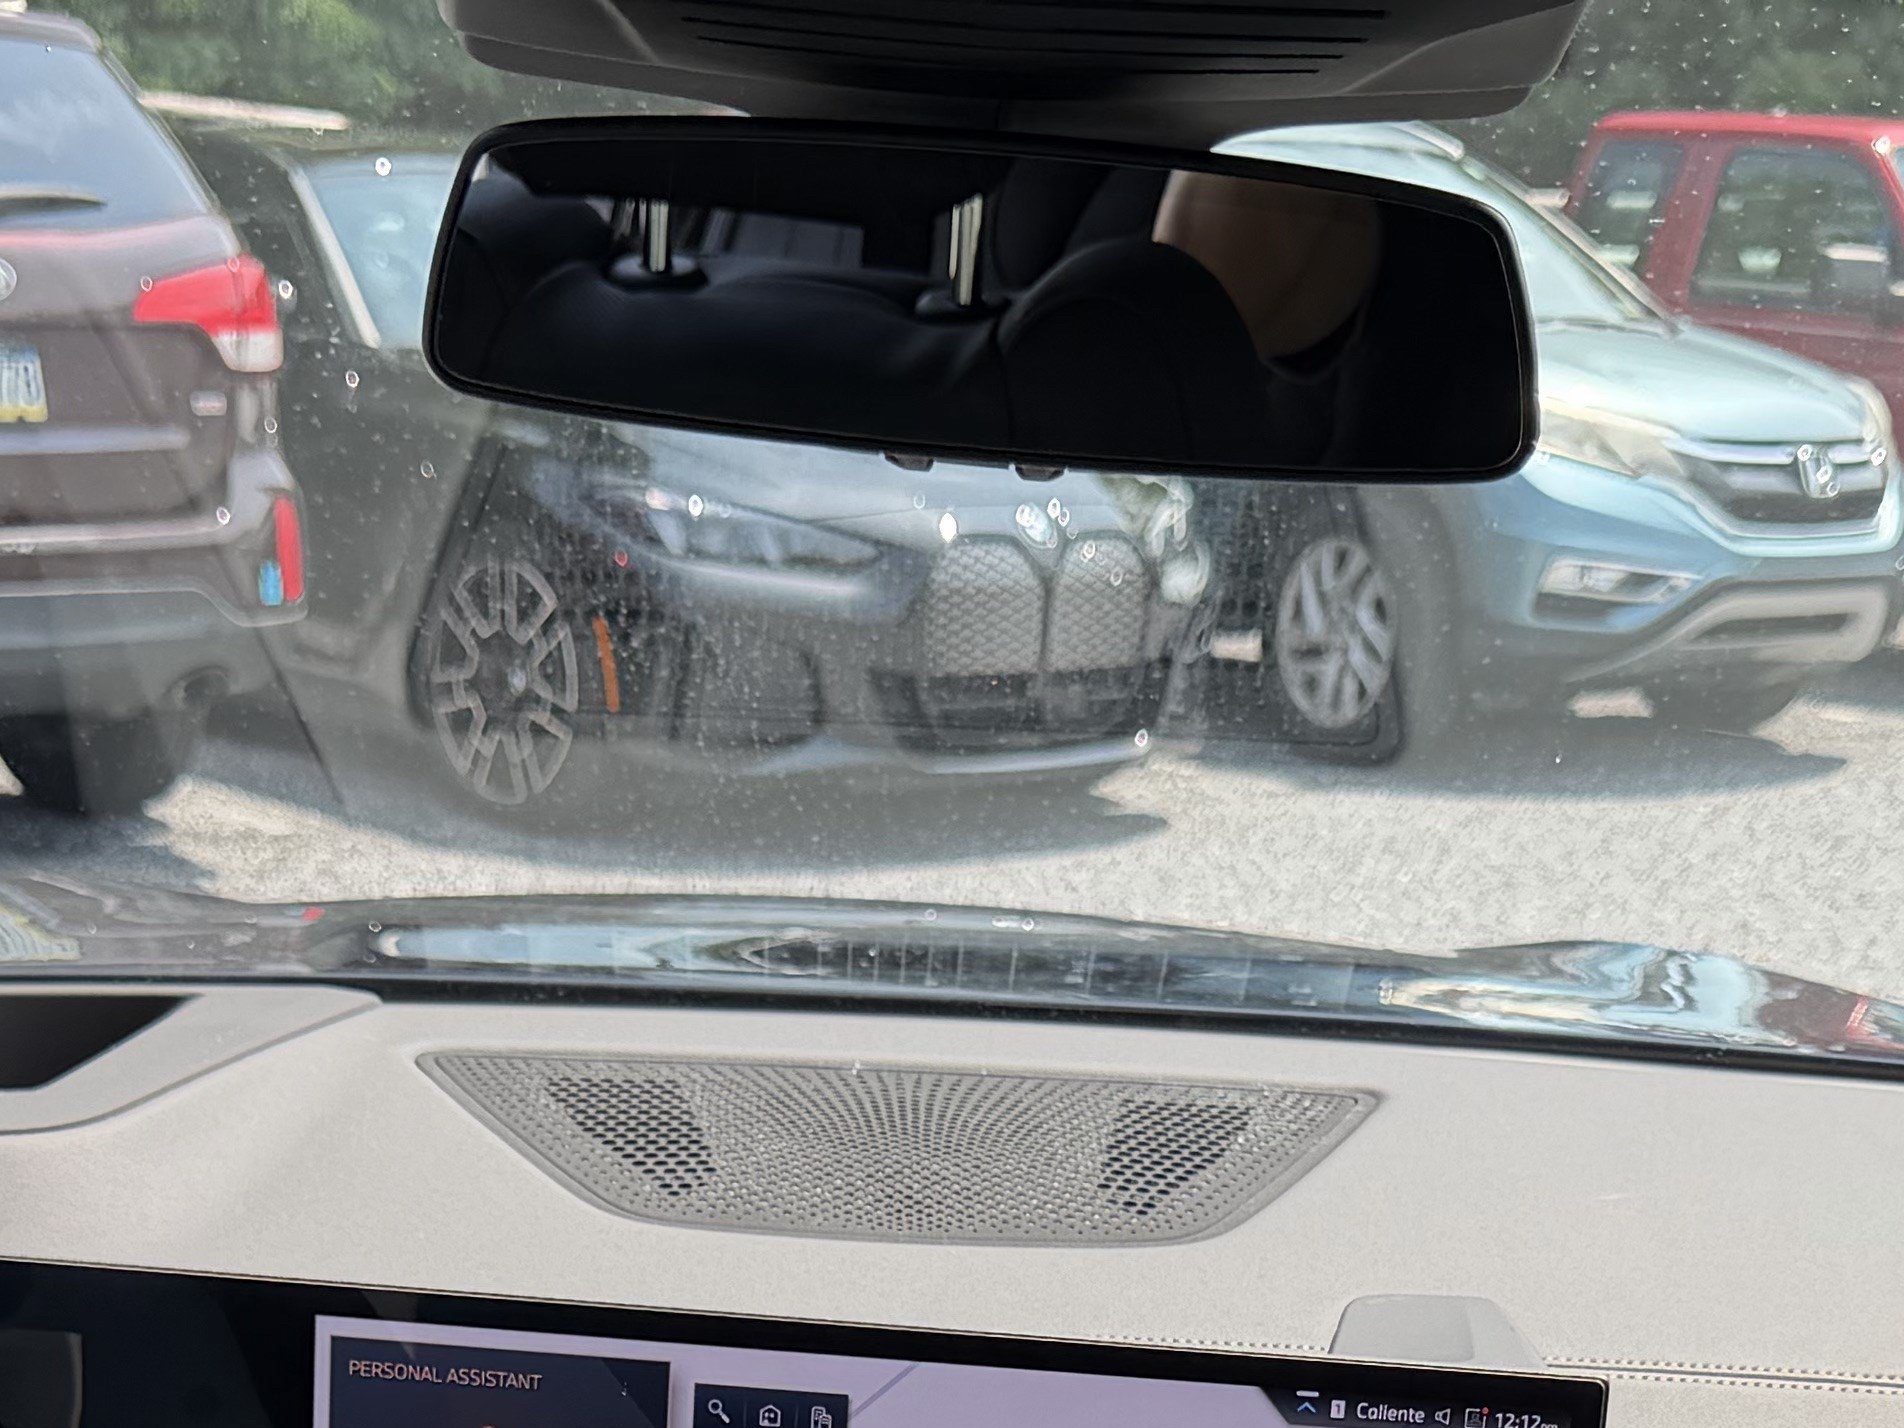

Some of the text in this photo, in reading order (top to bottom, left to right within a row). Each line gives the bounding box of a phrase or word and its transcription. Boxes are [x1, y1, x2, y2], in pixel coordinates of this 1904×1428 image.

[348, 1360, 543, 1390] PERSONAL ASSISTANT
[1356, 1402, 1426, 1423] Caliente
